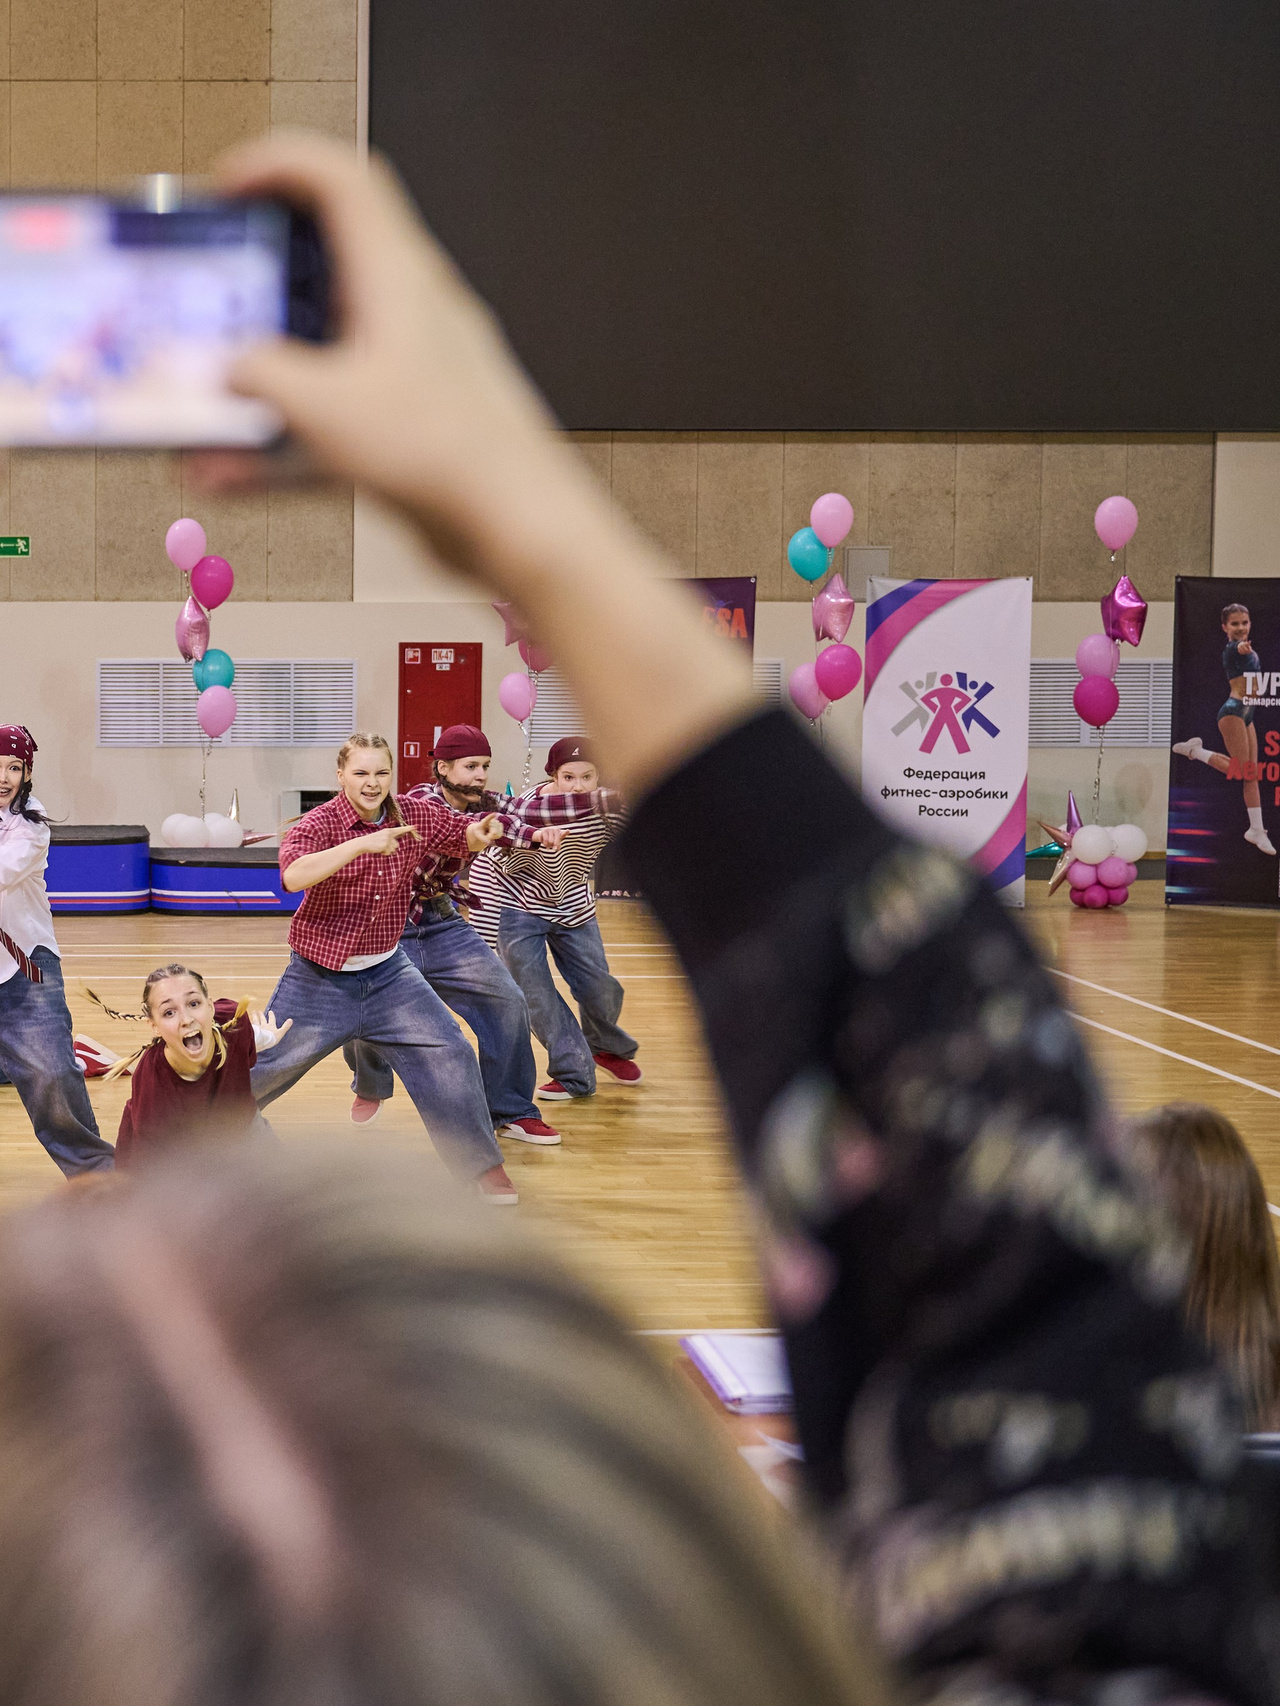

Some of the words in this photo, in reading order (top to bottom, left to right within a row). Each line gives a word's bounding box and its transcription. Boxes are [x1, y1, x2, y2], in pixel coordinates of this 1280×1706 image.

[903, 767, 986, 782] Федерация
[880, 786, 1008, 801] фитнес-аэробики
[918, 805, 969, 817] России
